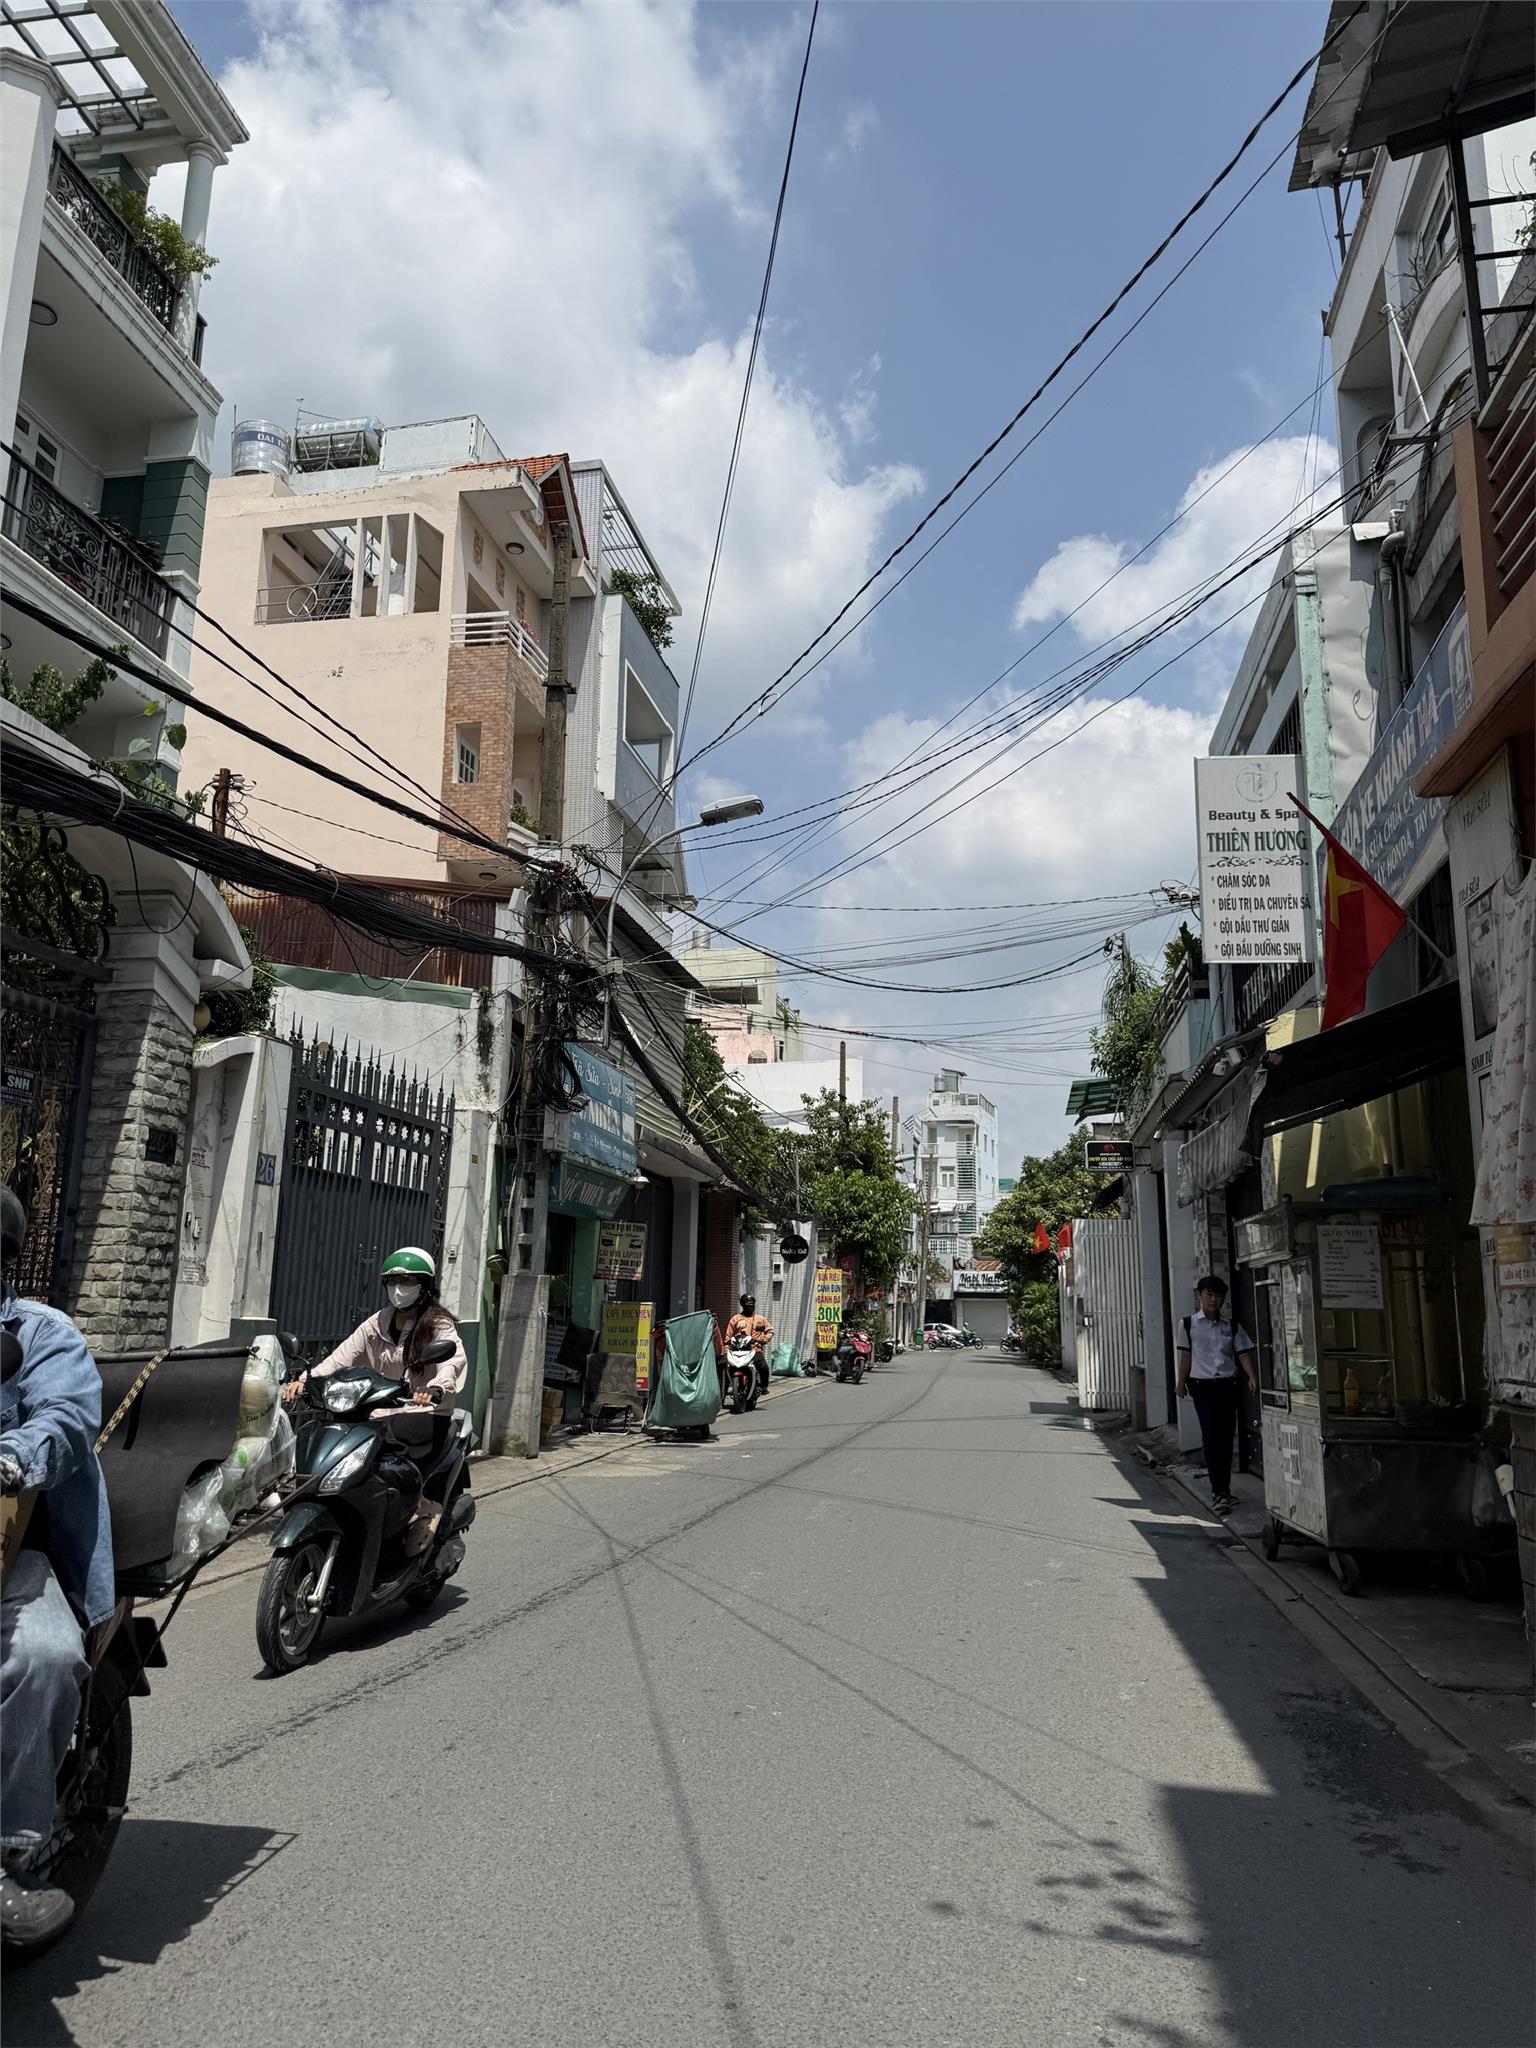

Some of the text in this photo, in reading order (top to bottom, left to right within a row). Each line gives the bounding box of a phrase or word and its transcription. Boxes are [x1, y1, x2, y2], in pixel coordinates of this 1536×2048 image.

[1208, 808, 1300, 822] Beauty & Spa
[1206, 827, 1307, 852] THIÊN HƯƠNG
[1216, 871, 1271, 888] CHĂM SÓC DA
[1239, 897, 1253, 914] TRỊ
[1254, 897, 1266, 910] DA
[1267, 893, 1298, 910] CHUYÊN
[1219, 917, 1233, 937] GỘI
[1252, 918, 1270, 933] THƯ
[1220, 940, 1234, 959] GỘI
[1254, 938, 1281, 956] DƯỠNG
[1283, 942, 1302, 956] SINH
[1471, 1053, 1485, 1072] SINH
[7, 1075, 30, 1090] SNH
[257, 1155, 274, 1184] 26
[818, 1306, 840, 1322] 30K
